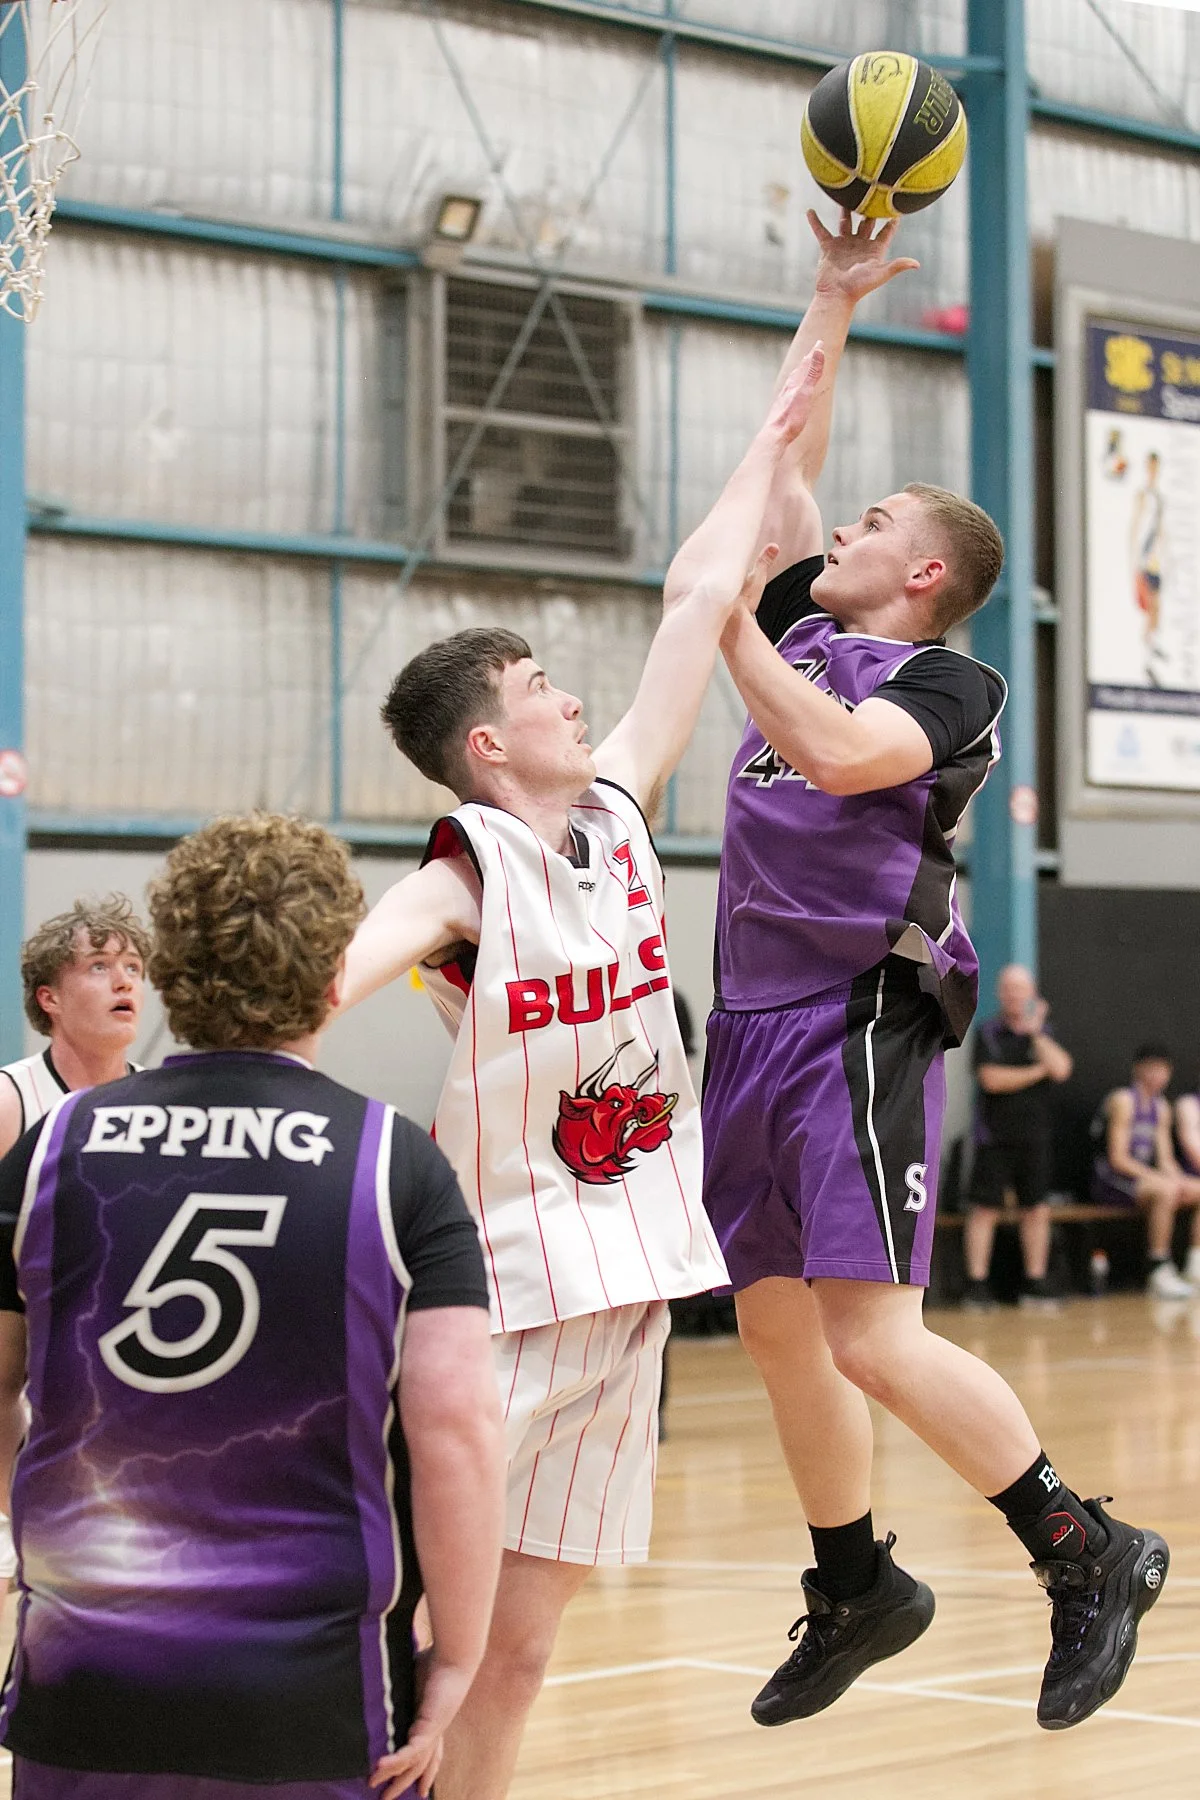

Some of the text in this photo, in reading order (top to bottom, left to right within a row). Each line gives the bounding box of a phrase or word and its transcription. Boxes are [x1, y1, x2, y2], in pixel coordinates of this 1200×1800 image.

[80, 1105, 335, 1166] EPPING
[903, 1162, 928, 1213] S
[97, 1192, 288, 1394] 5
